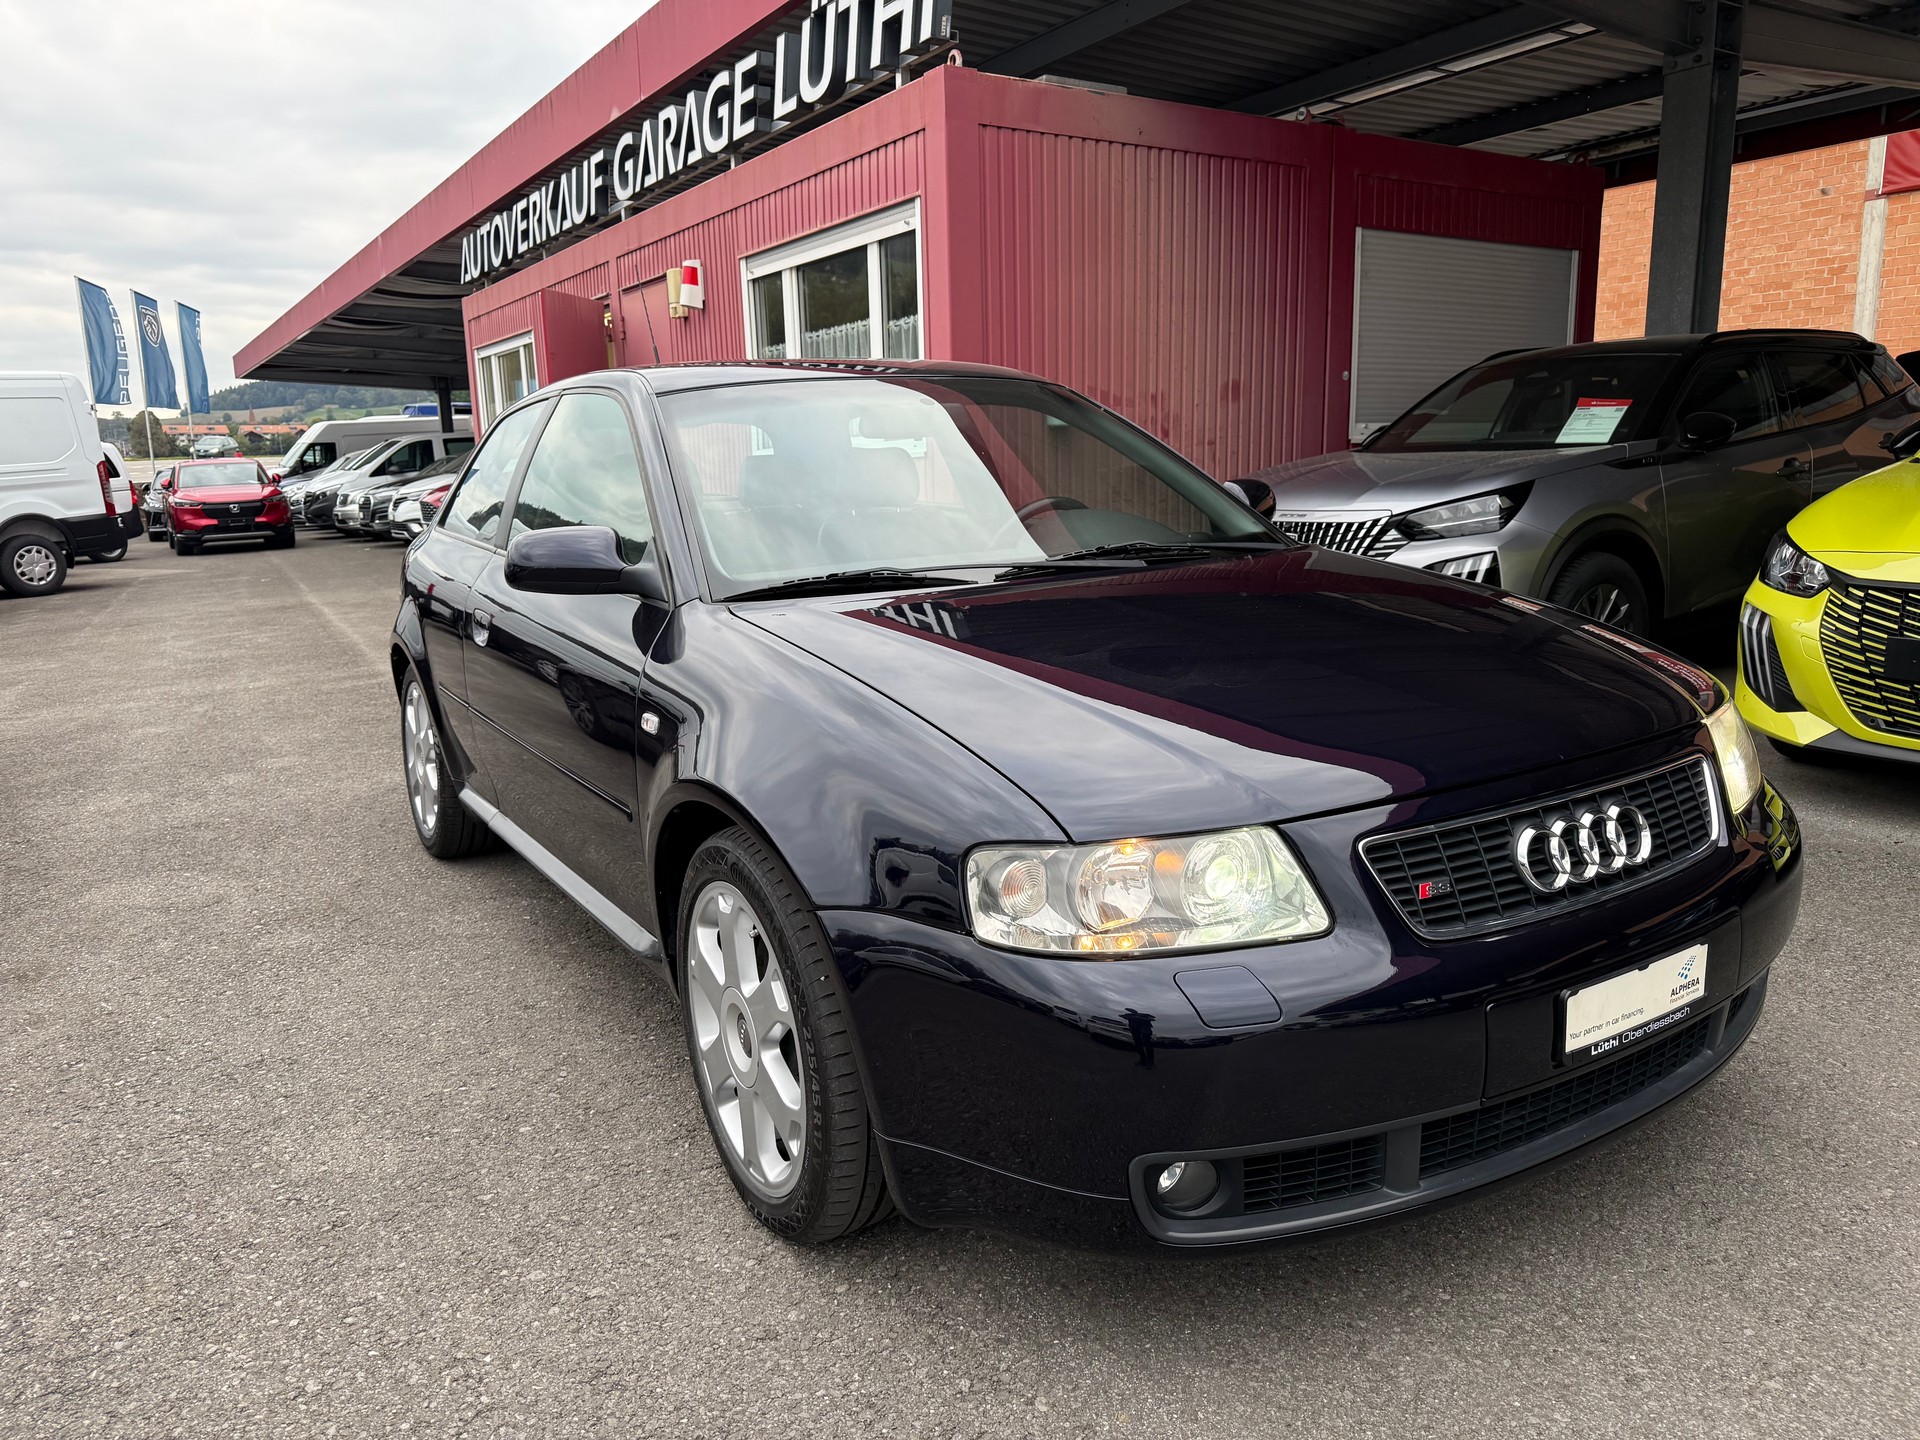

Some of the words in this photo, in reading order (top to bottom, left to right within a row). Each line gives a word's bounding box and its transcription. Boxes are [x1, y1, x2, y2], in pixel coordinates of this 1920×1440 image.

[461, 149, 603, 284] AUTOVERKAUF
[613, 50, 760, 201] GARAGE
[101, 289, 132, 404] PEUGEO
[1569, 1030, 1583, 1041] Your
[1583, 1023, 1605, 1037] partner
[1605, 1019, 1611, 1027] in
[1611, 1016, 1620, 1025] car
[1620, 1006, 1645, 1022] financing.
[1670, 977, 1700, 998] ALPHERA
[1591, 1036, 1619, 1056] Lüthi
[1622, 1006, 1690, 1043] Oberdiessbach
[803, 1025, 821, 1107] 225/45
[813, 1129, 822, 1151] 17
